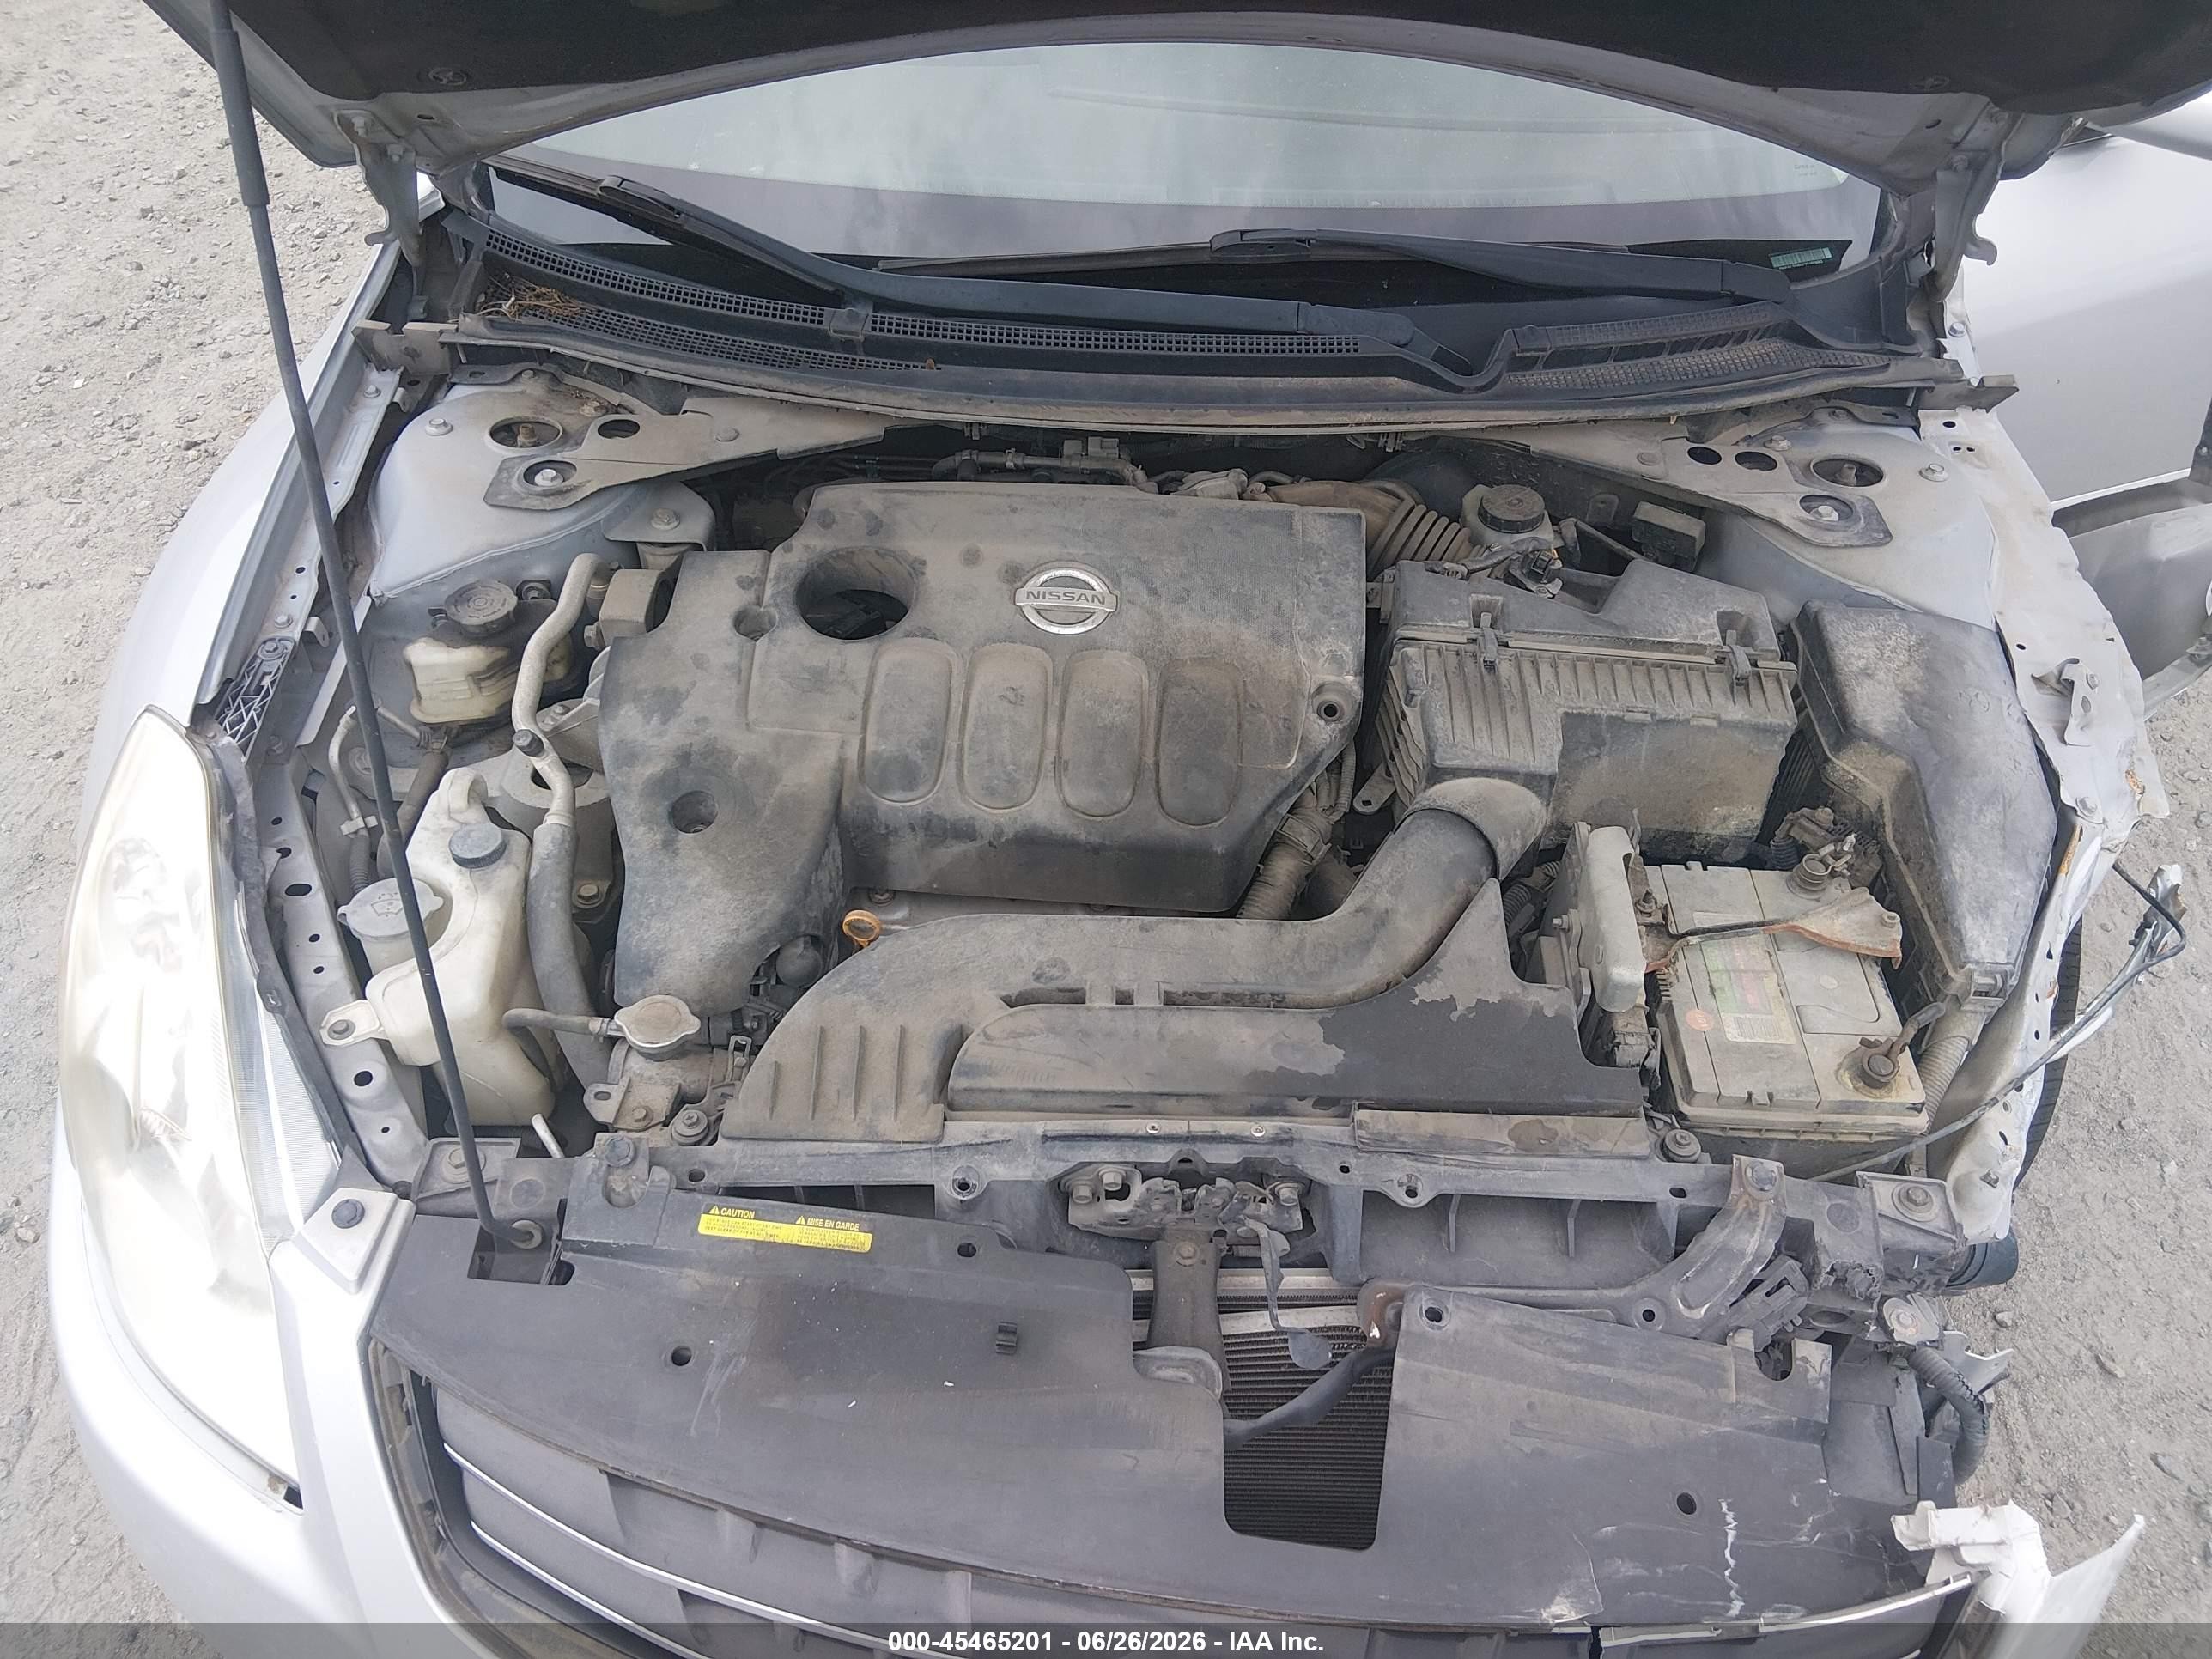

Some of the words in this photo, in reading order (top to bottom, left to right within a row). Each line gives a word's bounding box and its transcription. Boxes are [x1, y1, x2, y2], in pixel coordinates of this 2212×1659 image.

[1026, 590, 1105, 605] NISSAN
[720, 1207, 756, 1219] CAUTION
[807, 1218, 823, 1227] MISE
[824, 1219, 835, 1229] EN
[836, 1221, 860, 1231] GARDE
